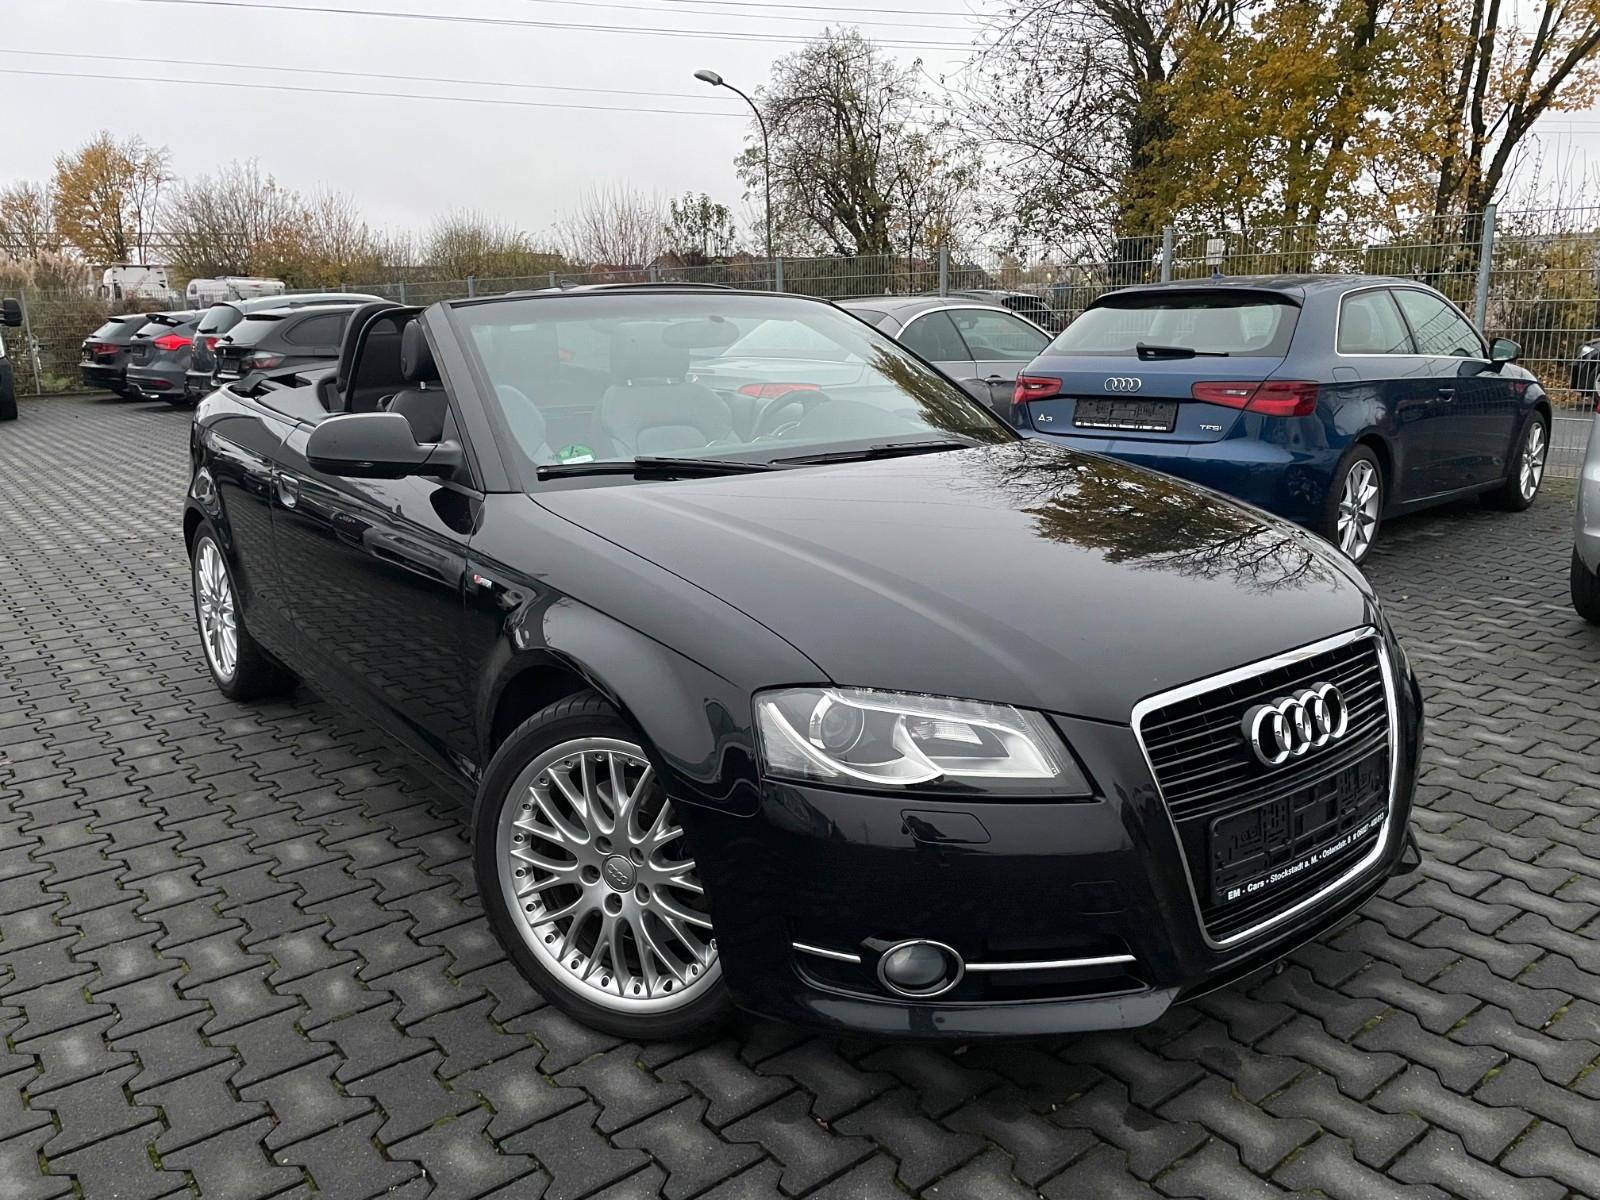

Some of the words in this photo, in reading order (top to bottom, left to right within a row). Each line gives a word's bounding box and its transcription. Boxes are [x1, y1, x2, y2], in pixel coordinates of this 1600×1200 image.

[1038, 413, 1053, 422] A3
[1227, 888, 1241, 900] EM
[1247, 880, 1265, 892] Cars
[1270, 861, 1304, 883] Stockstadt
